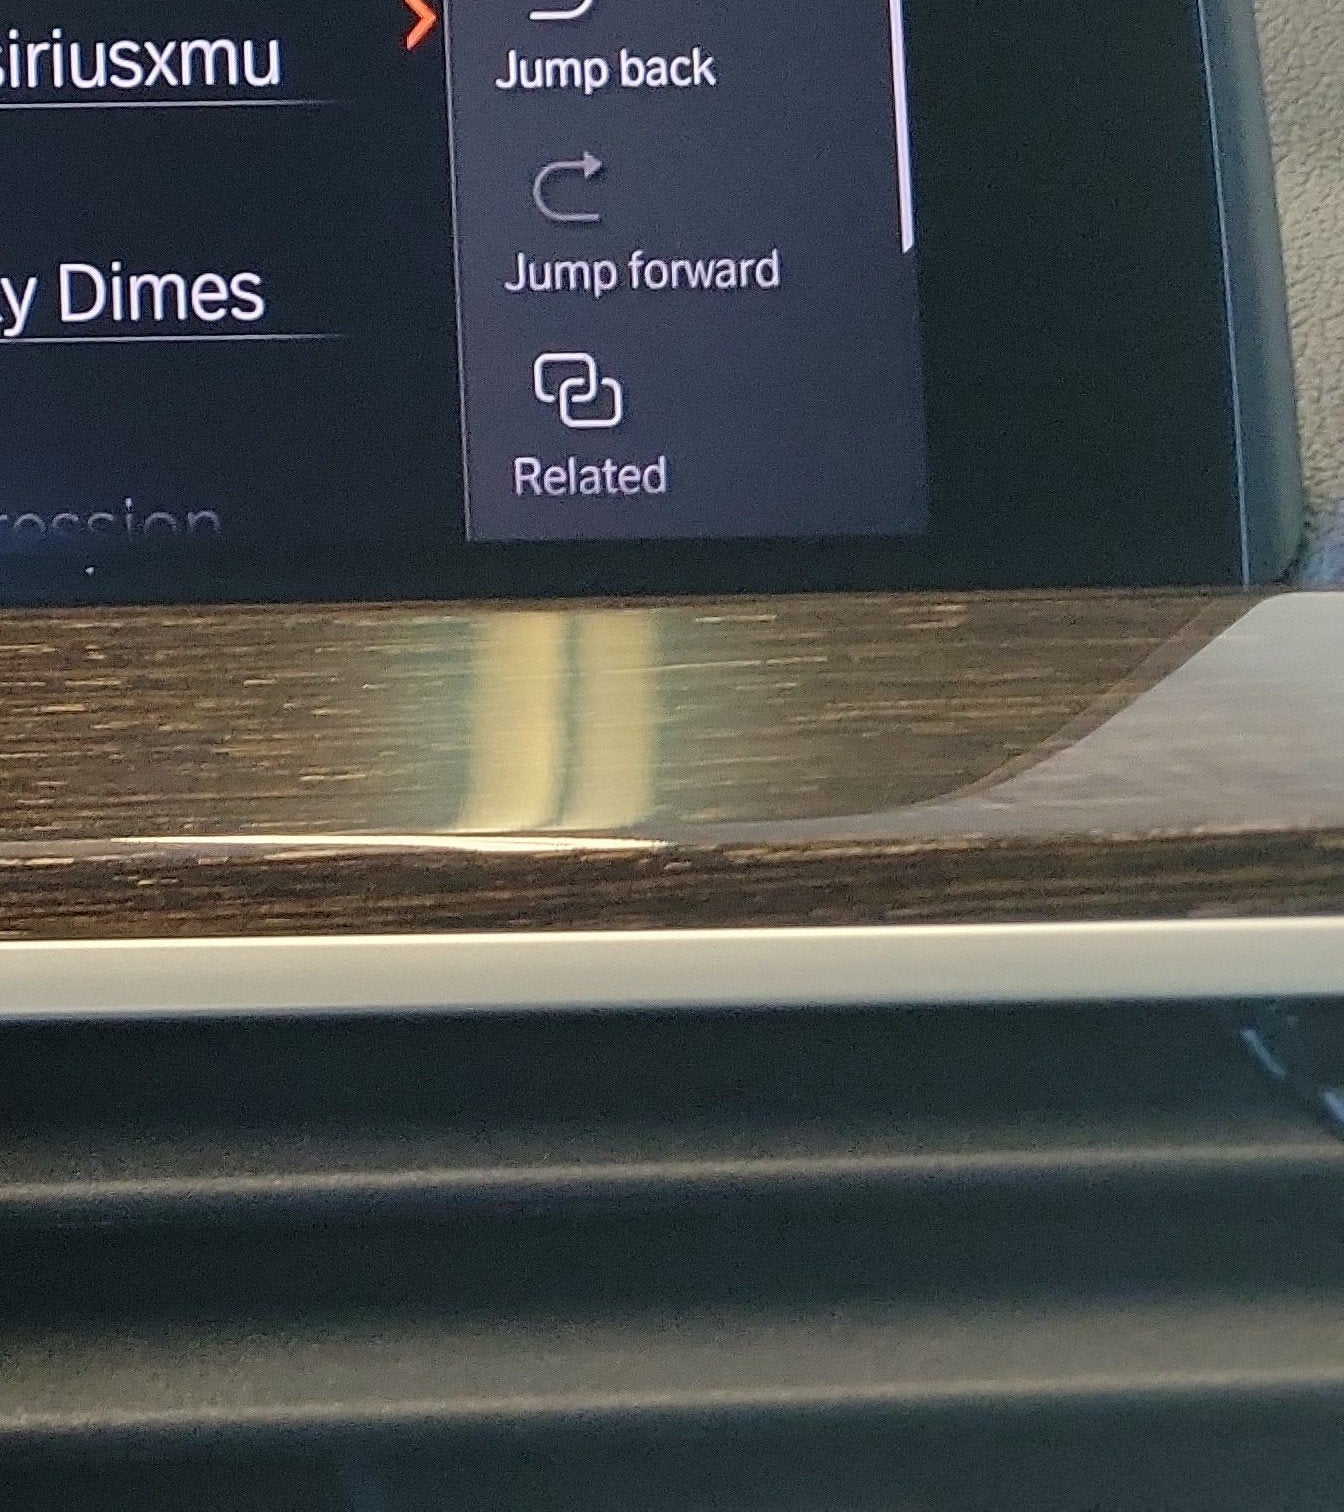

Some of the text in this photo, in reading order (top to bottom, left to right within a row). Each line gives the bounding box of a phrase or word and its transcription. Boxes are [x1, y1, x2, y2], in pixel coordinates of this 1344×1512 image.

[494, 46, 718, 96] Jump back
[58, 260, 266, 323] Dimes
[503, 248, 781, 299] Jump forward
[513, 454, 667, 496] Related
